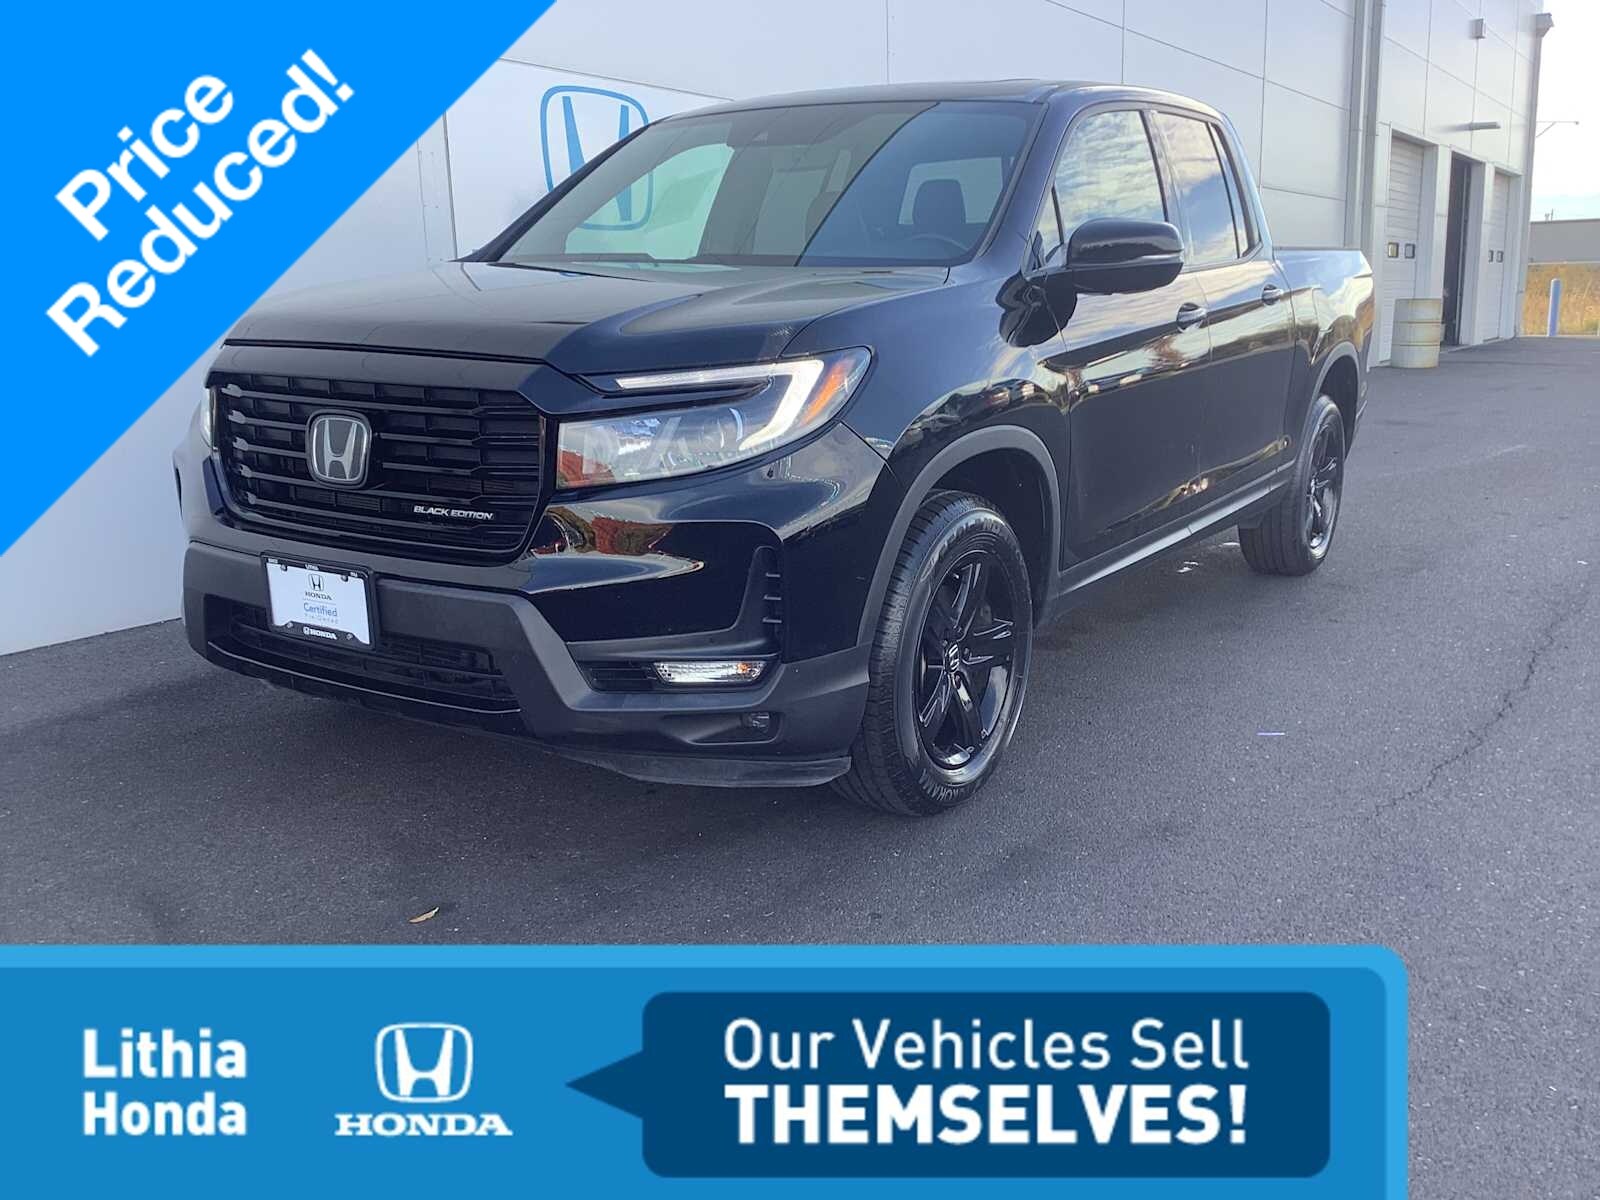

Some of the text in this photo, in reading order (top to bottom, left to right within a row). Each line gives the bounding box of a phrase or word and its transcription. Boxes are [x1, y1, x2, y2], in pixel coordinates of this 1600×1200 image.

[413, 505, 494, 520] BLACK EDITION
[305, 591, 333, 600] HONDA
[303, 602, 338, 617] Certified
[310, 628, 338, 640] HONDA
